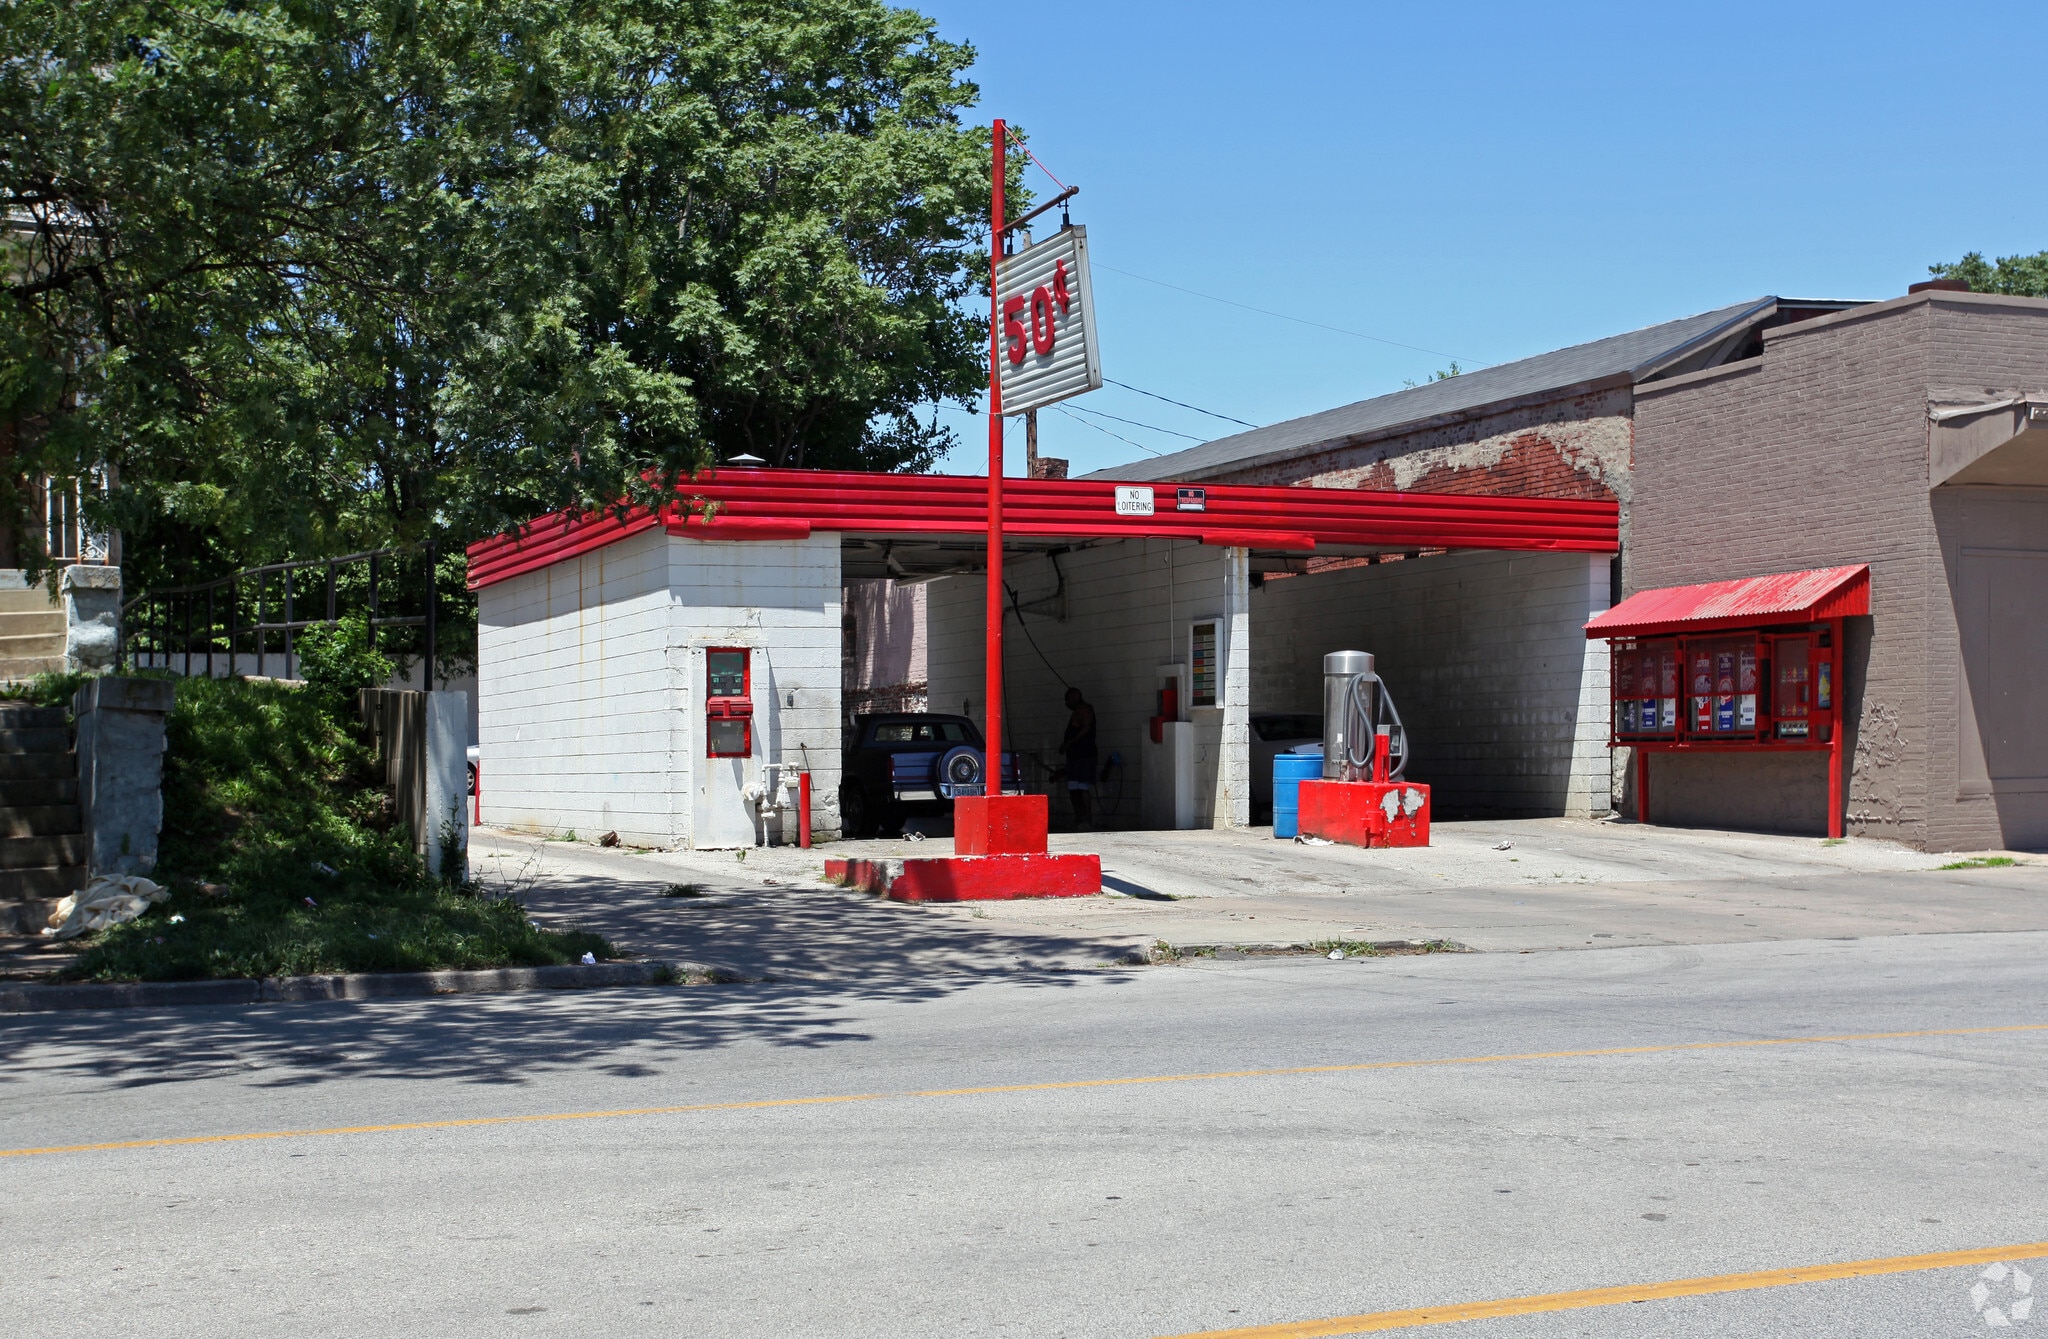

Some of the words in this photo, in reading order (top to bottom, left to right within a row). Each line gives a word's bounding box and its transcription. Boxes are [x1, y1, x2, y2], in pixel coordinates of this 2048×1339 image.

[1003, 259, 1070, 365] 50¢
[1130, 490, 1140, 500] NO
[1118, 502, 1152, 511] LOITERING
